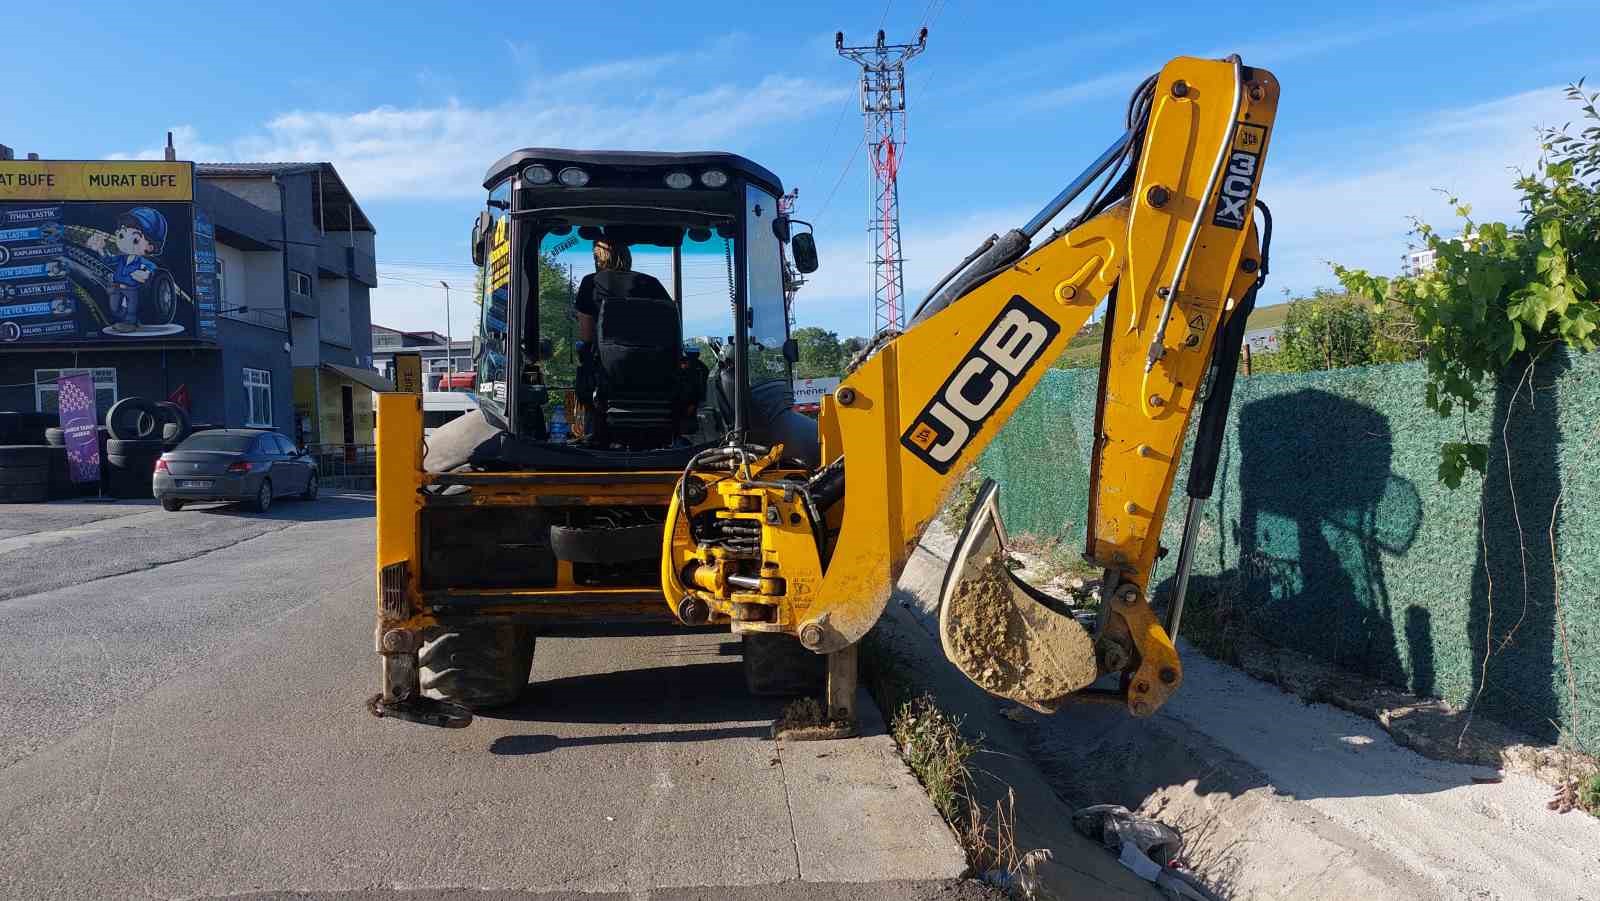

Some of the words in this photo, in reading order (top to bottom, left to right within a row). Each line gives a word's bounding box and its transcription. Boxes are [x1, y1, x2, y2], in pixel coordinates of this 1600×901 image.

[89, 174, 136, 187] MURAT
[1217, 153, 1256, 219] 3CX
[929, 309, 1048, 462] JCB
